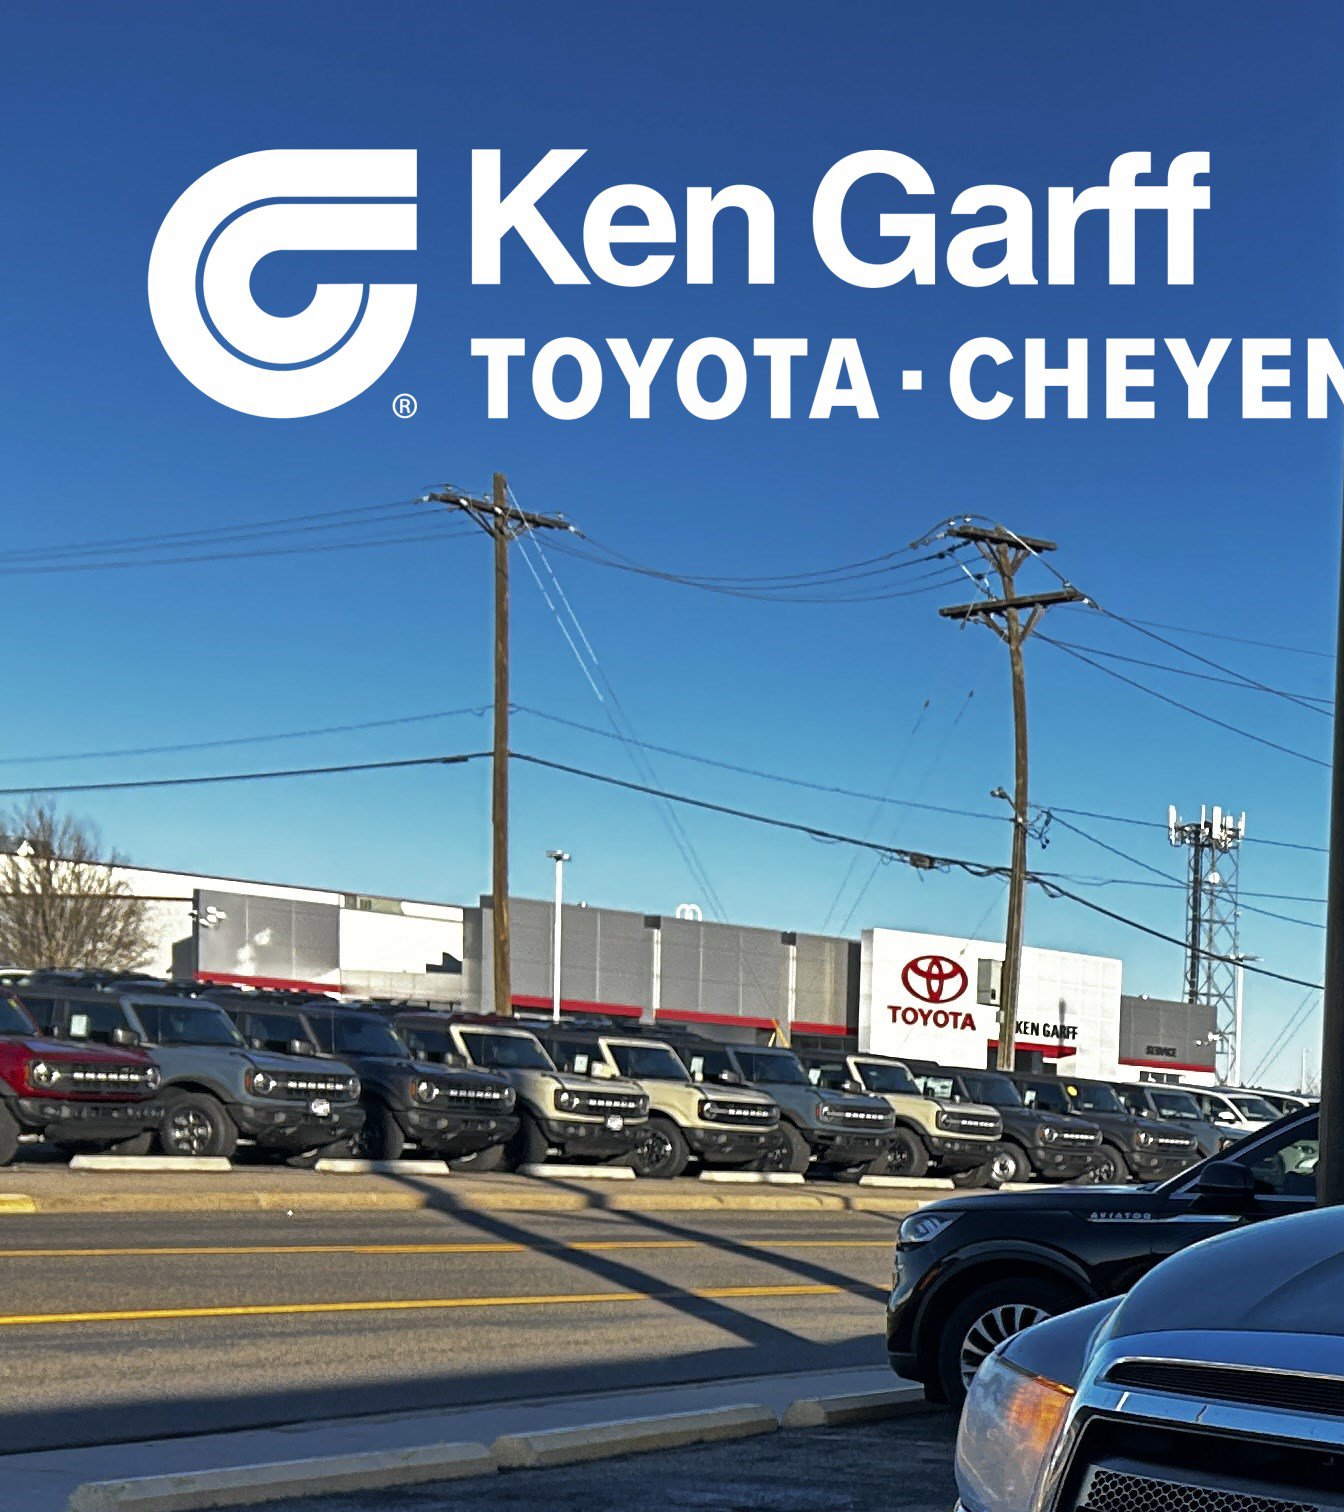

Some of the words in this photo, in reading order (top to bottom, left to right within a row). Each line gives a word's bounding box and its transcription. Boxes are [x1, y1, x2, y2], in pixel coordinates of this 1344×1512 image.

[887, 1004, 977, 1032] TOYOTA
[1015, 1020, 1040, 1037] KEN
[1042, 1022, 1078, 1040] GARFF
